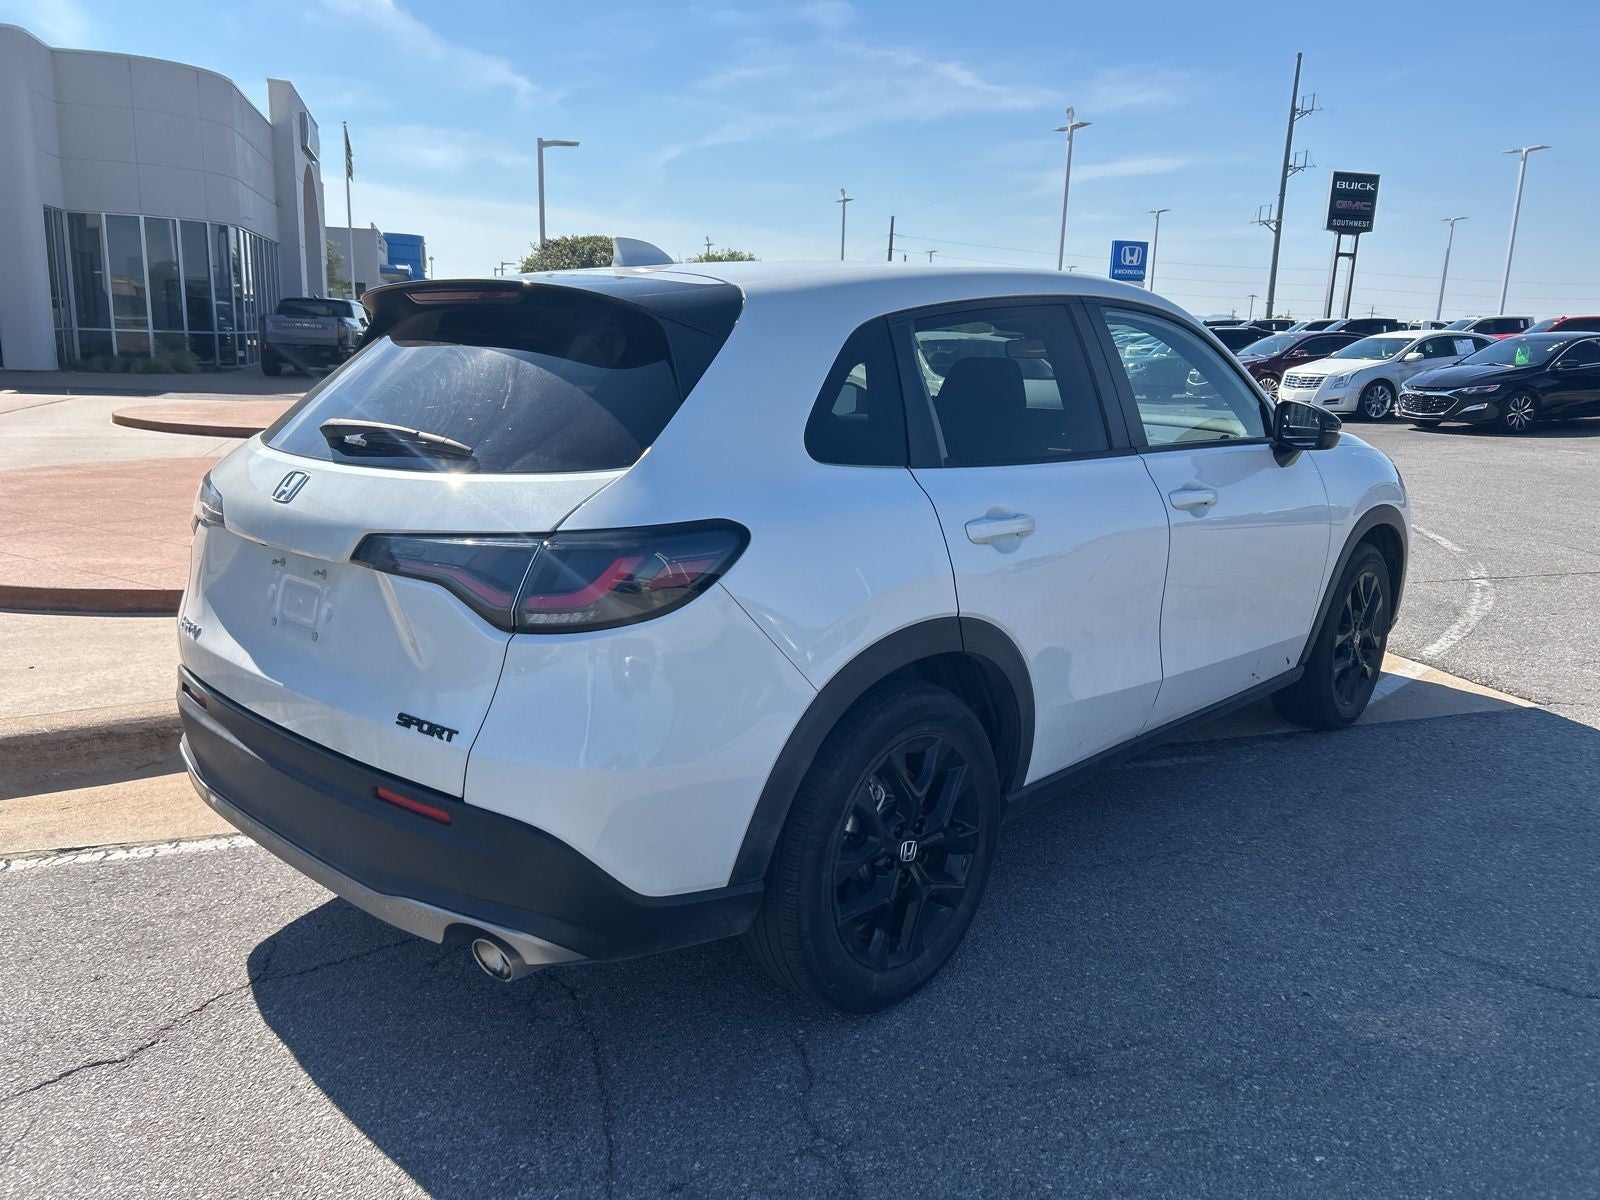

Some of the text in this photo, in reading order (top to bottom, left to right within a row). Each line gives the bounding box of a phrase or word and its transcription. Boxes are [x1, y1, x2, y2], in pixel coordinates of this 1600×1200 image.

[1336, 181, 1375, 191] BUICK
[1336, 200, 1371, 210] GMC
[1332, 219, 1370, 227] SOUTHWEST
[395, 712, 459, 742] SPORT
